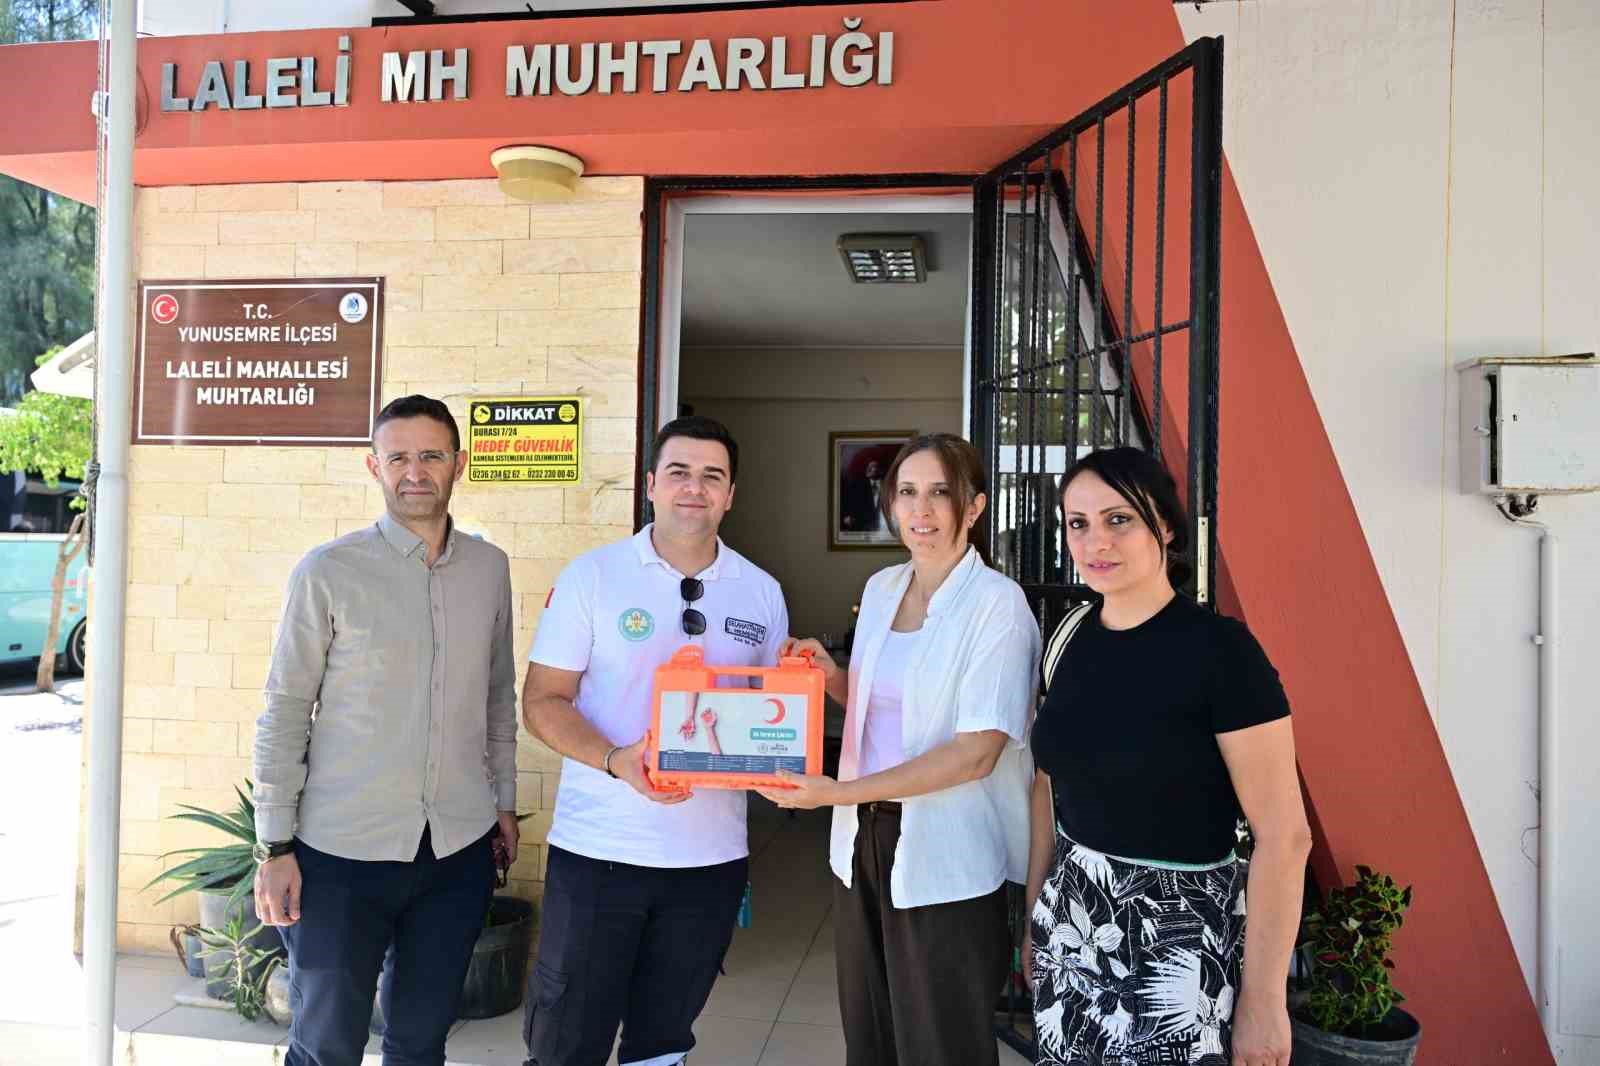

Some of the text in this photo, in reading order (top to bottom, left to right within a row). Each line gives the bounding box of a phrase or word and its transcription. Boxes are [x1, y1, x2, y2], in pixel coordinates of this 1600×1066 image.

[161, 16, 895, 112] LALELİ MH MUHTARLIĞI
[243, 304, 272, 319] T.C.
[178, 323, 337, 346] YUNUSEMRE İLÇESİ
[166, 356, 348, 379] LALELİ MAHALLESİ
[197, 383, 314, 405] MUHTARLIĞI
[494, 405, 556, 421] DİKKAT
[474, 427, 517, 436] BURASI 7/24
[474, 435, 575, 453] HEDEF GÜVENLİK
